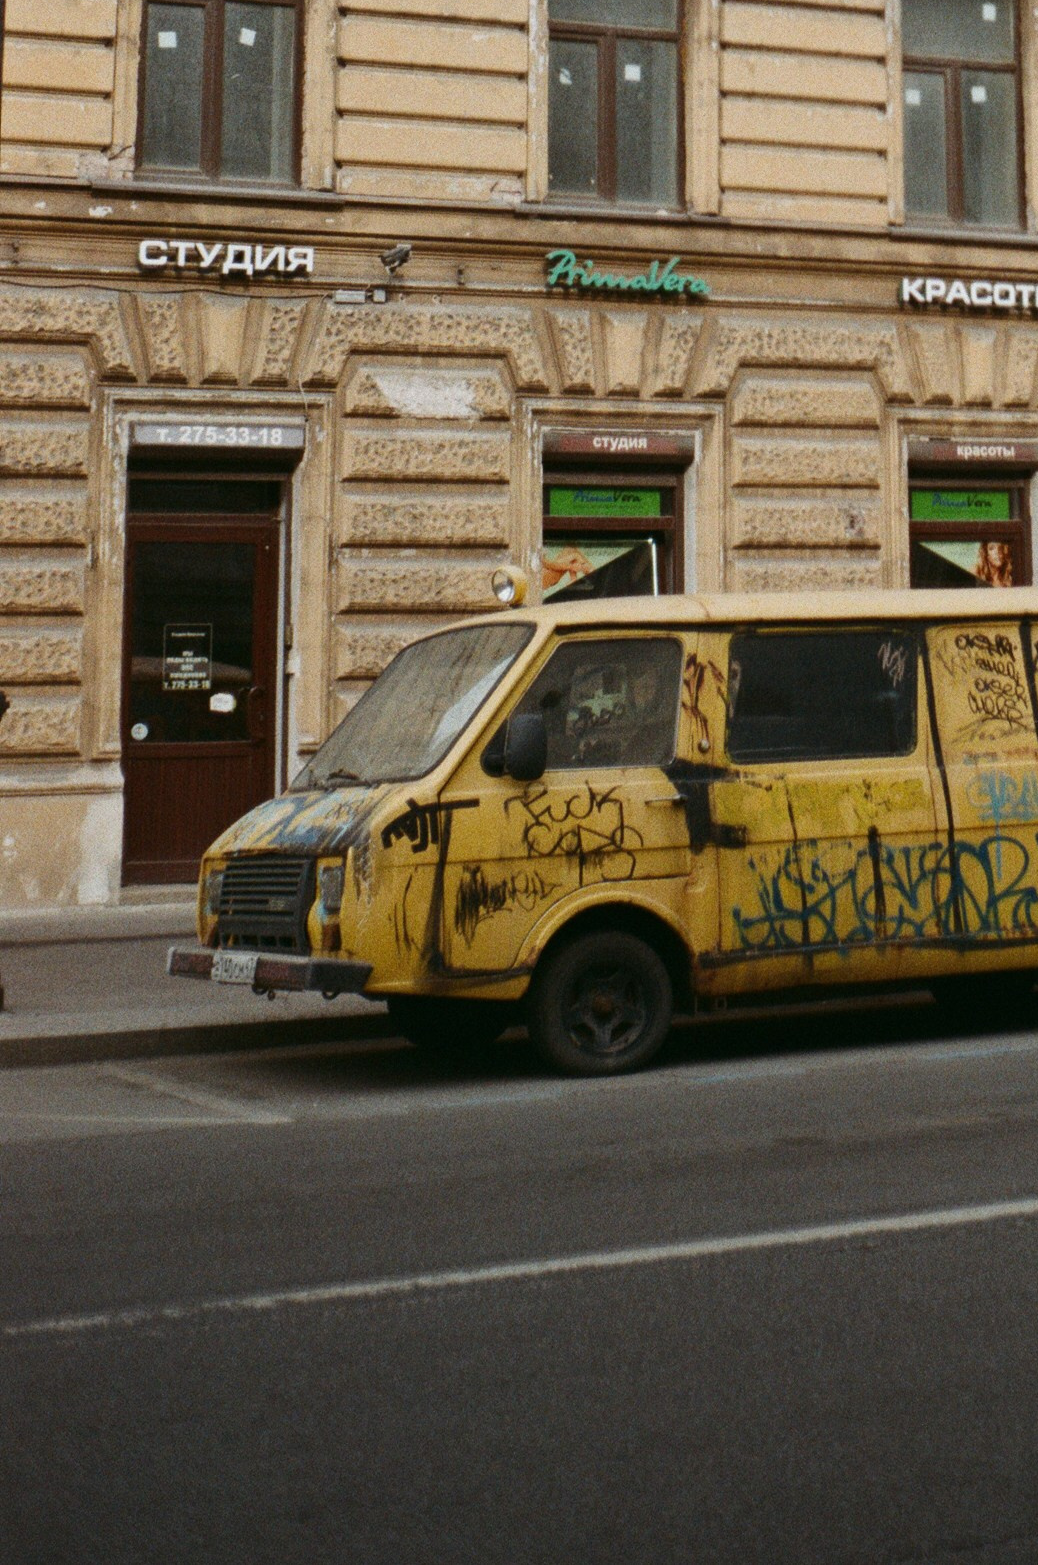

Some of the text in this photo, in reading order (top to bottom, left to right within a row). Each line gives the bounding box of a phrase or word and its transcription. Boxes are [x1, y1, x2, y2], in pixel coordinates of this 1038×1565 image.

[138, 239, 315, 276] СТУДИЯ
[179, 425, 283, 446] 275-33-18
[592, 436, 648, 451] студия
[956, 445, 1015, 461] красоты
